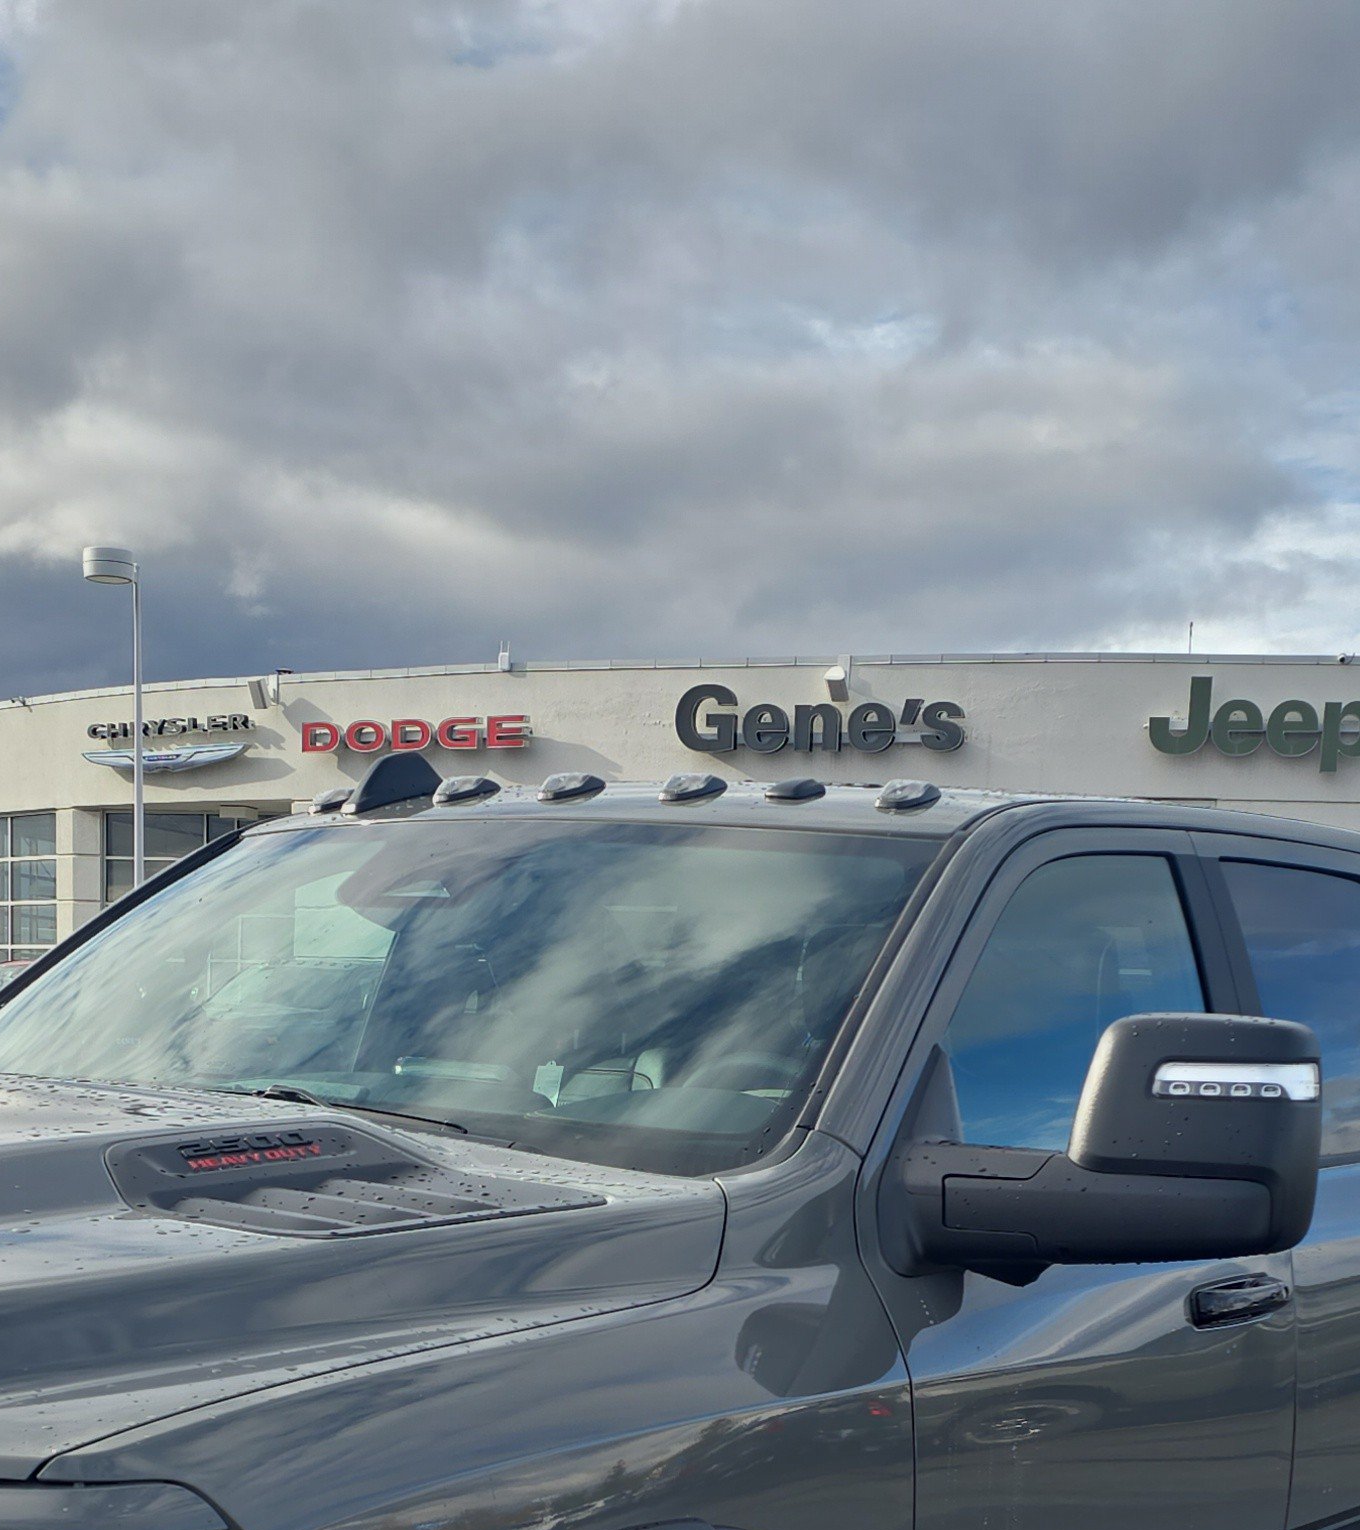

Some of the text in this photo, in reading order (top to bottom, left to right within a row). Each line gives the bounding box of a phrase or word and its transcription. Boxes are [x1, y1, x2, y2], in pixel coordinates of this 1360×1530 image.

[87, 713, 251, 740] CHRYSLER
[675, 684, 965, 754] Gene's
[301, 715, 530, 753] DODGE
[177, 1132, 313, 1160] 2500
[188, 1143, 321, 1172] HEAVY DUTY
